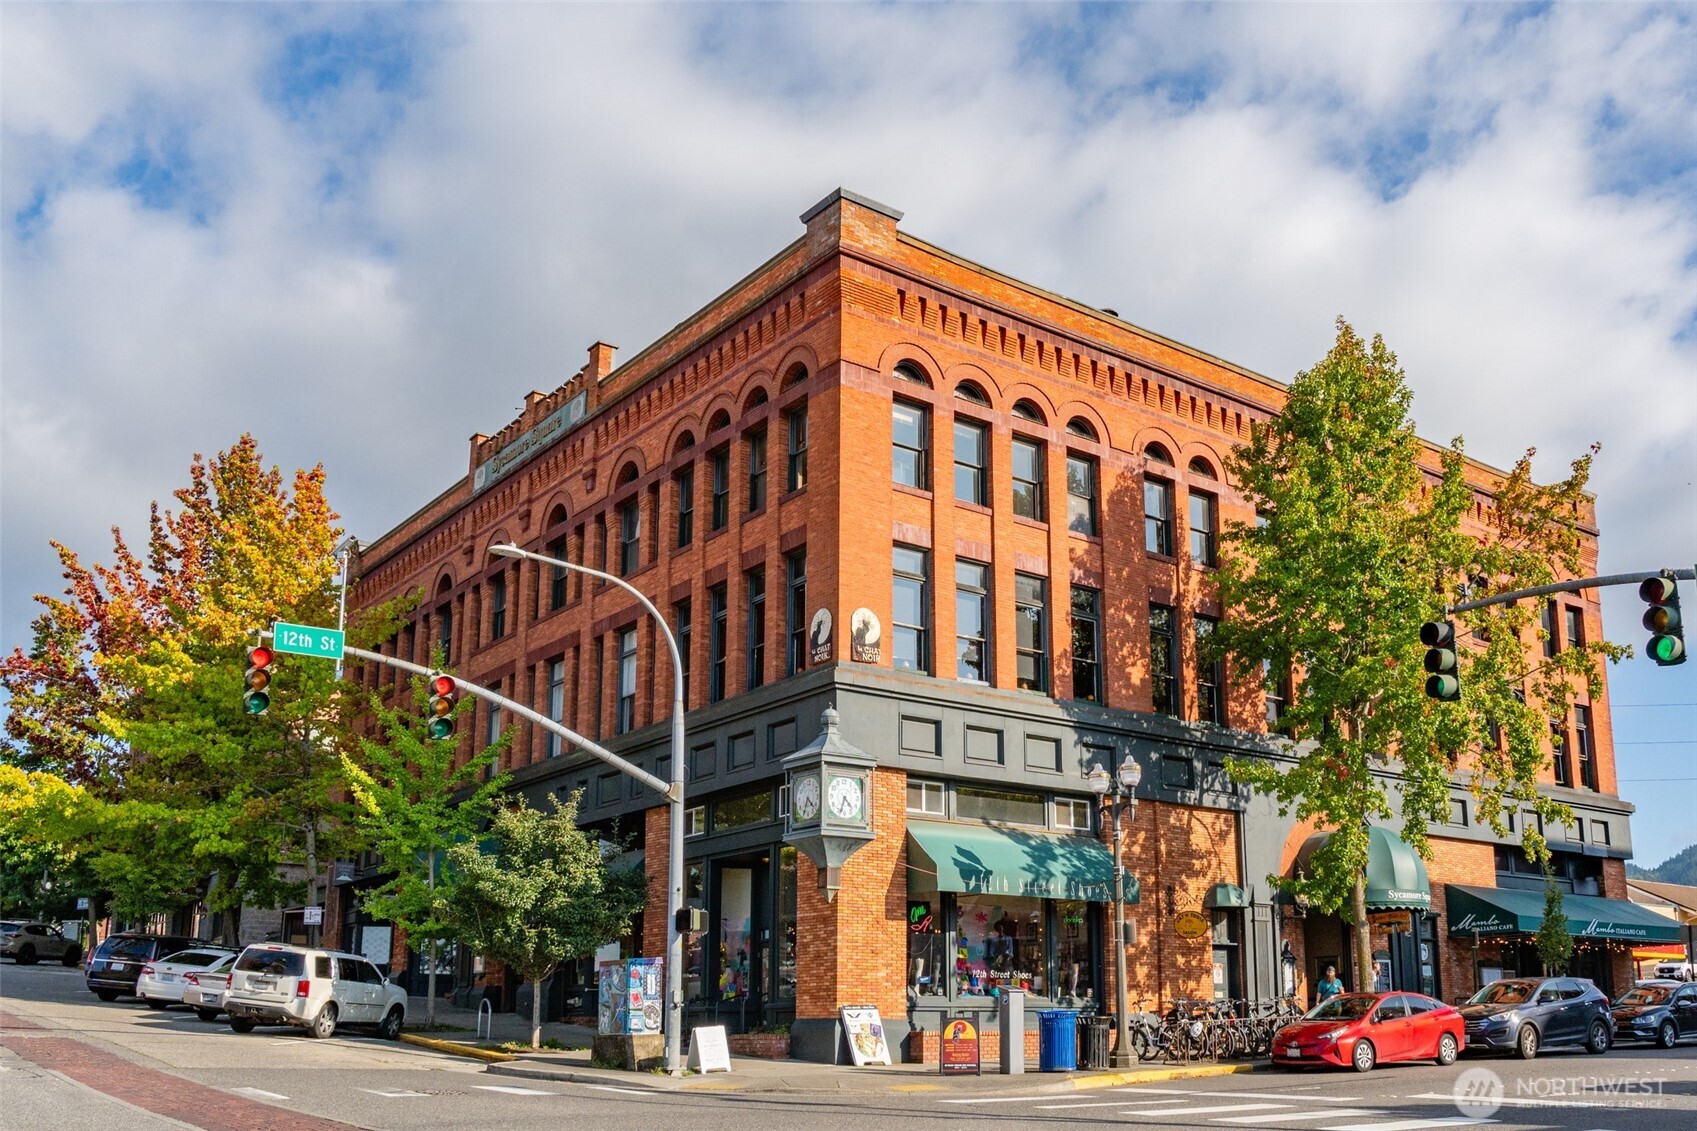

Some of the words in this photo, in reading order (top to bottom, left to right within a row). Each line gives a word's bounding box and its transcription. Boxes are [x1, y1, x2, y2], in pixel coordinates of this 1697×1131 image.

[283, 630, 313, 648] 12th
[320, 636, 336, 652] St
[816, 643, 831, 654] CHAT
[863, 646, 881, 655] CHAT
[862, 652, 881, 663] NOIR
[1018, 878, 1062, 896] Street
[1070, 881, 1107, 899] Shoes
[1388, 889, 1421, 900] Sycamore
[910, 905, 926, 923] Open
[1451, 913, 1500, 931] Mambo
[1581, 918, 1616, 935] Mambo
[1616, 927, 1636, 935] ITALIANO
[972, 969, 987, 978] 12th
[990, 969, 1010, 979] Street
[1012, 970, 1033, 979] Shoes
